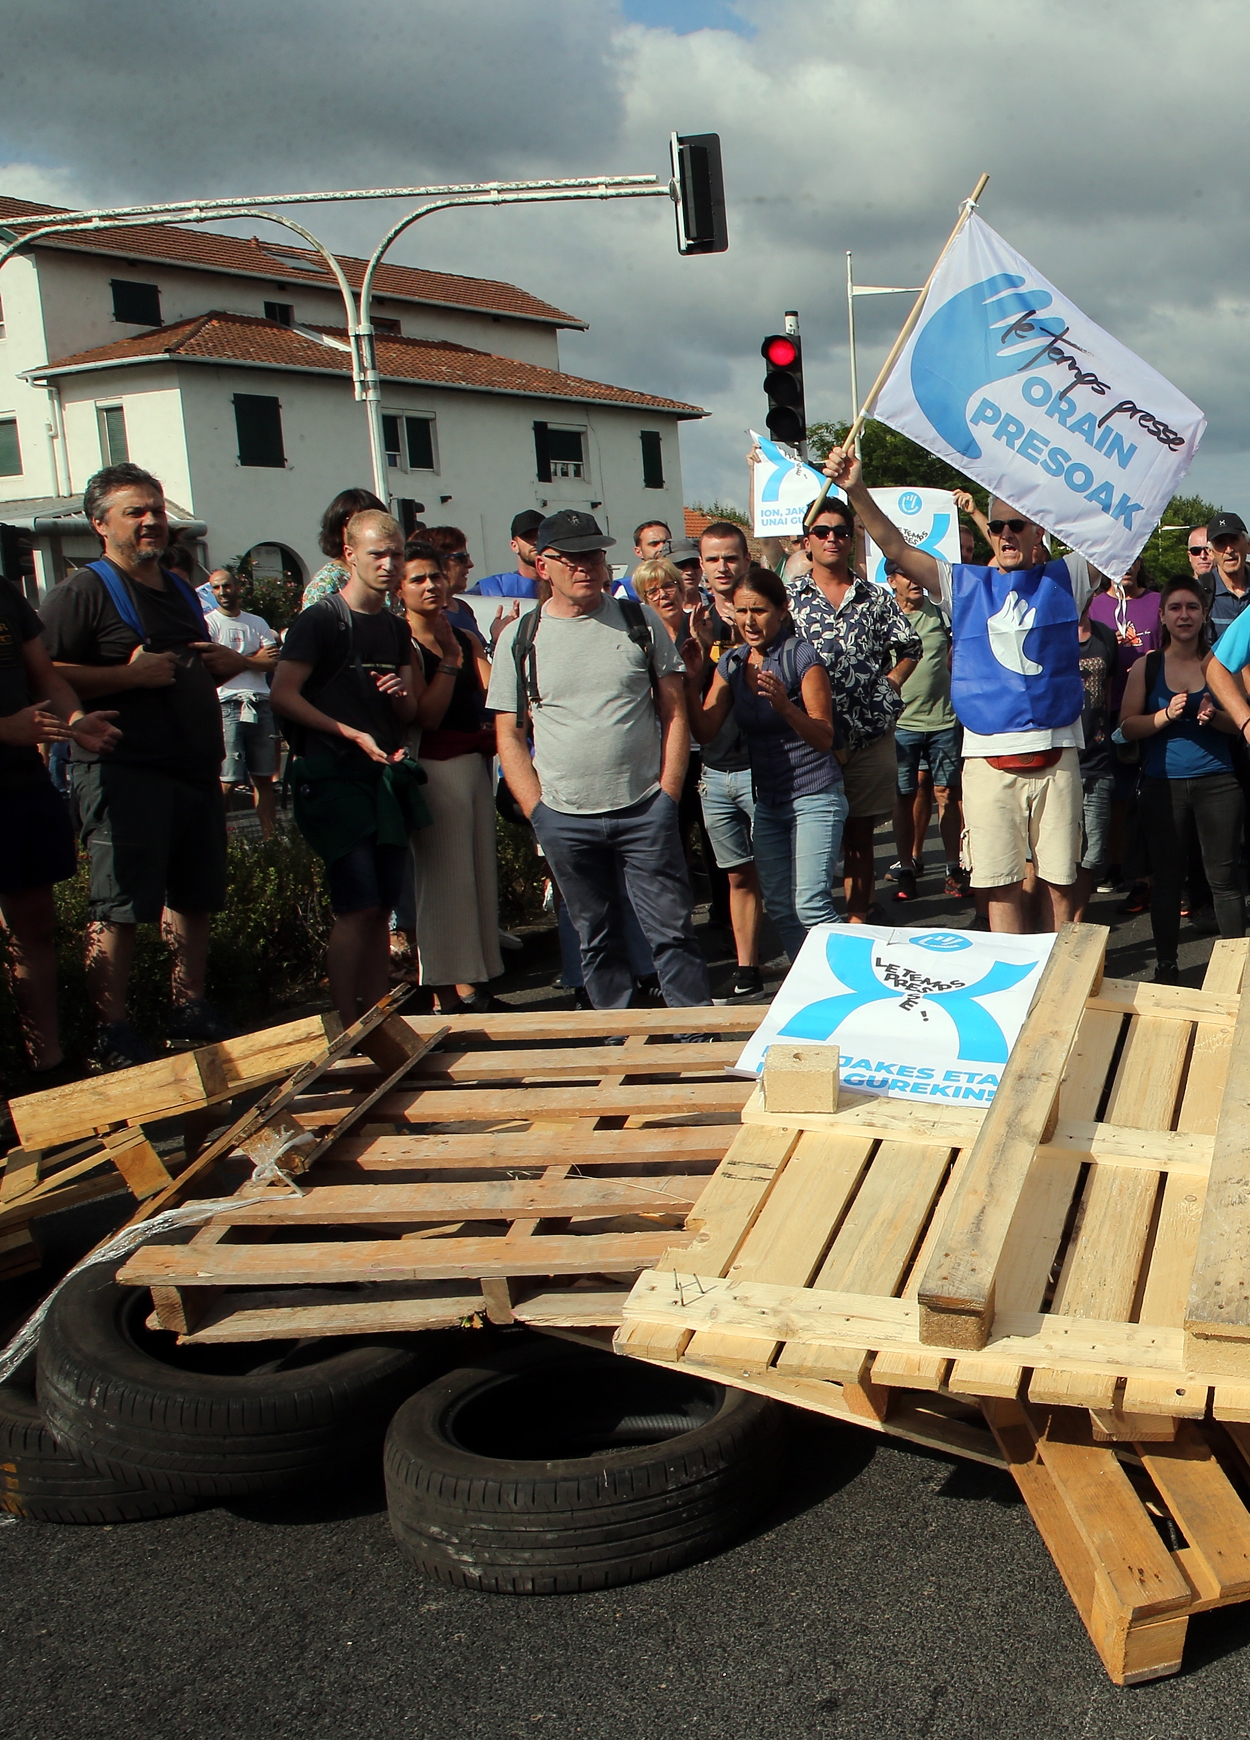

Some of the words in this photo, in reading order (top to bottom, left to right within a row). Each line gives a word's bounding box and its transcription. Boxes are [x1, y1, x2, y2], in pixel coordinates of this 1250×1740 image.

[1021, 376, 1138, 470] ORAIN
[1098, 400, 1185, 451] presse
[969, 397, 1145, 531] PRESOAK
[760, 509, 783, 517] ION,
[761, 517, 788, 527] UNAI
[903, 528, 928, 541] TEMPS
[875, 957, 901, 973] LE
[902, 968, 966, 991] TEMPS
[839, 1055, 936, 1080] JAKES
[942, 1070, 1000, 1087] ETA
[843, 1073, 996, 1103] GUREKIN!
